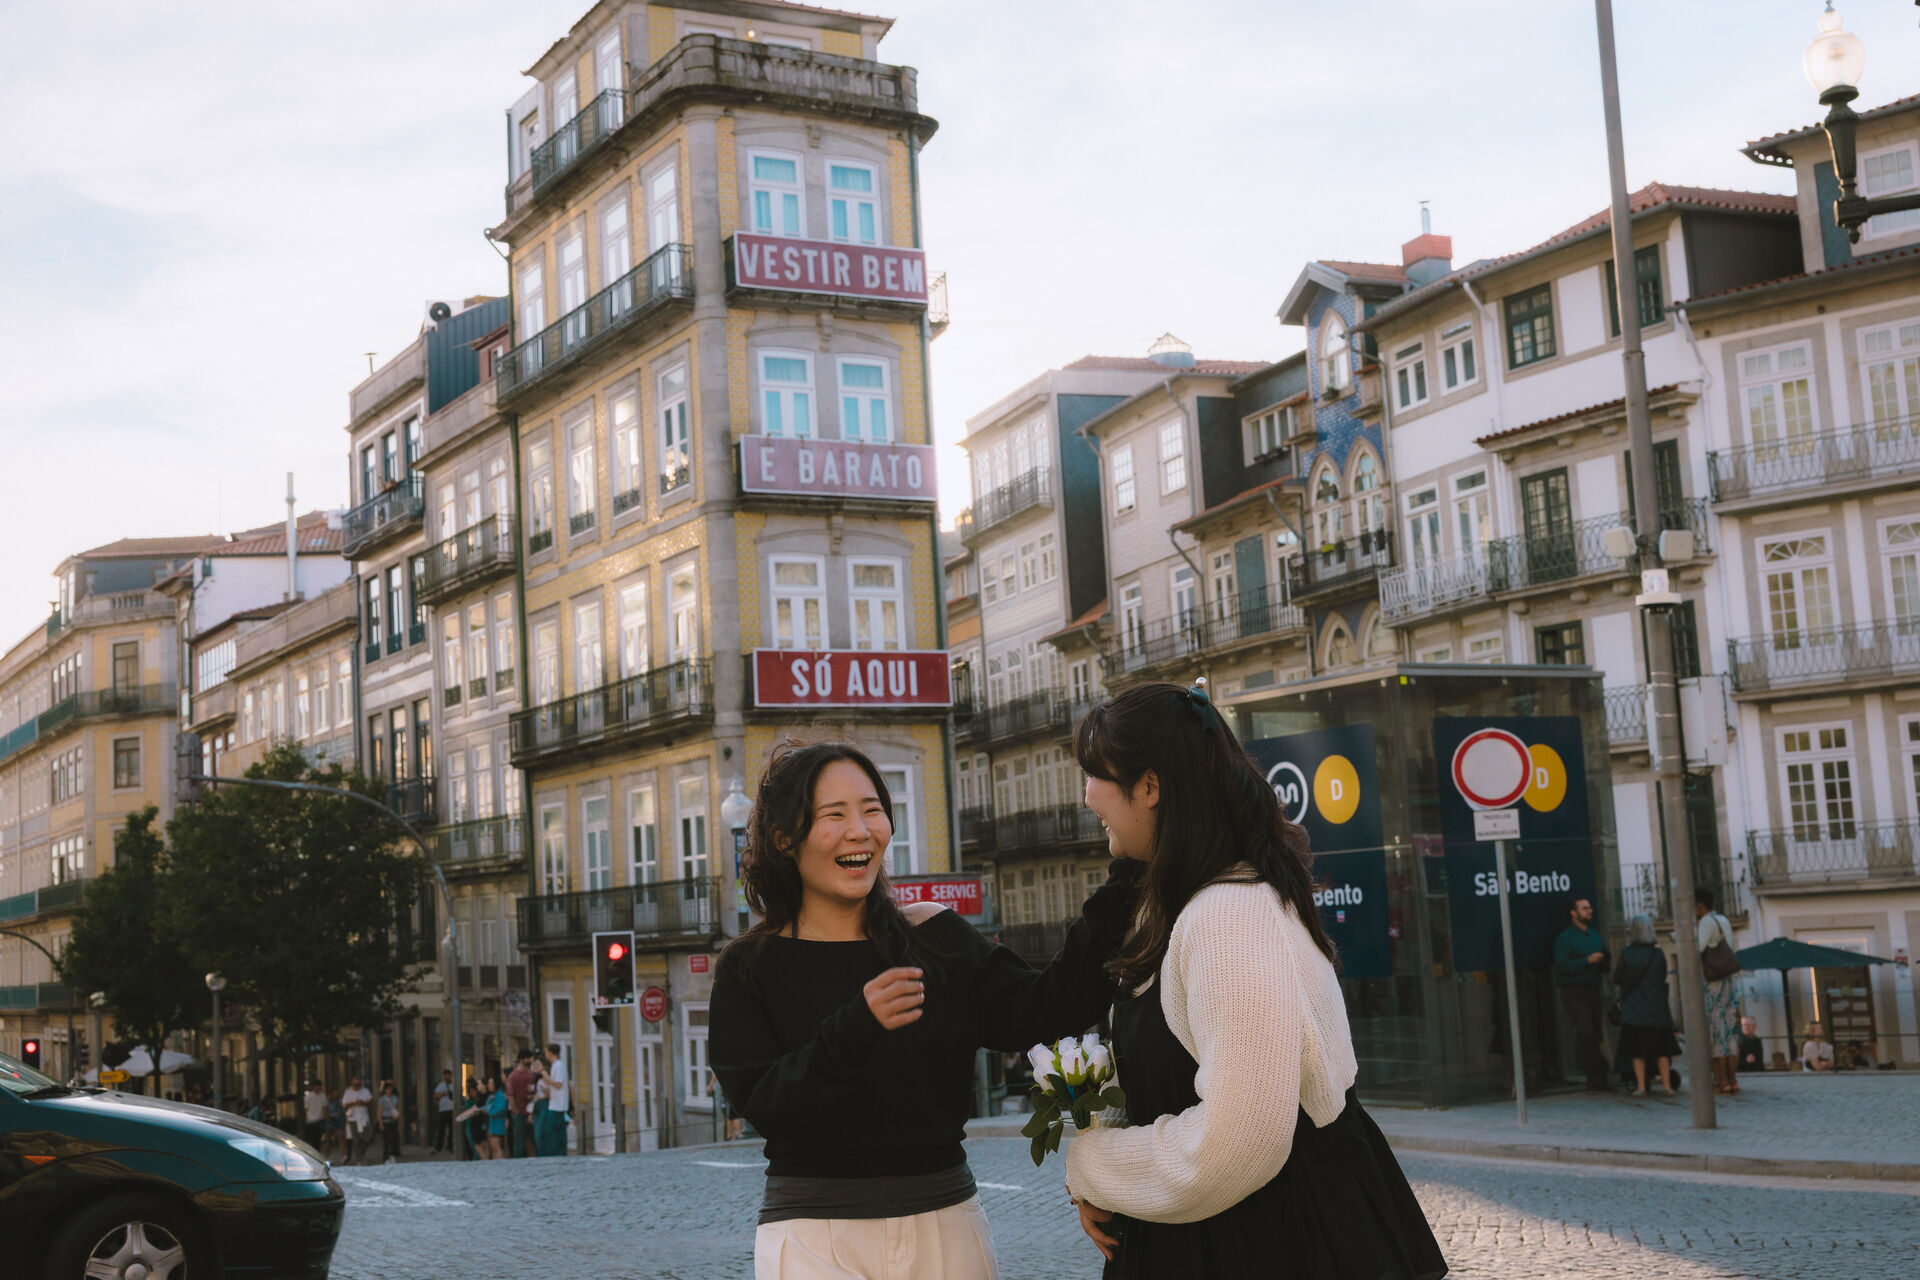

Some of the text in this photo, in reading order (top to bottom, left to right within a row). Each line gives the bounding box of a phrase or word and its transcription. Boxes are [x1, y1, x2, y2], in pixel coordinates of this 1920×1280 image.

[740, 242, 923, 293] VESTIR BEM
[760, 447, 922, 489] E BARATO
[791, 653, 918, 697] SÓ AQUI
[1330, 779, 1343, 801] D
[1535, 767, 1549, 789] D
[931, 883, 977, 900] SERVICE
[1515, 870, 1570, 894] Bento
